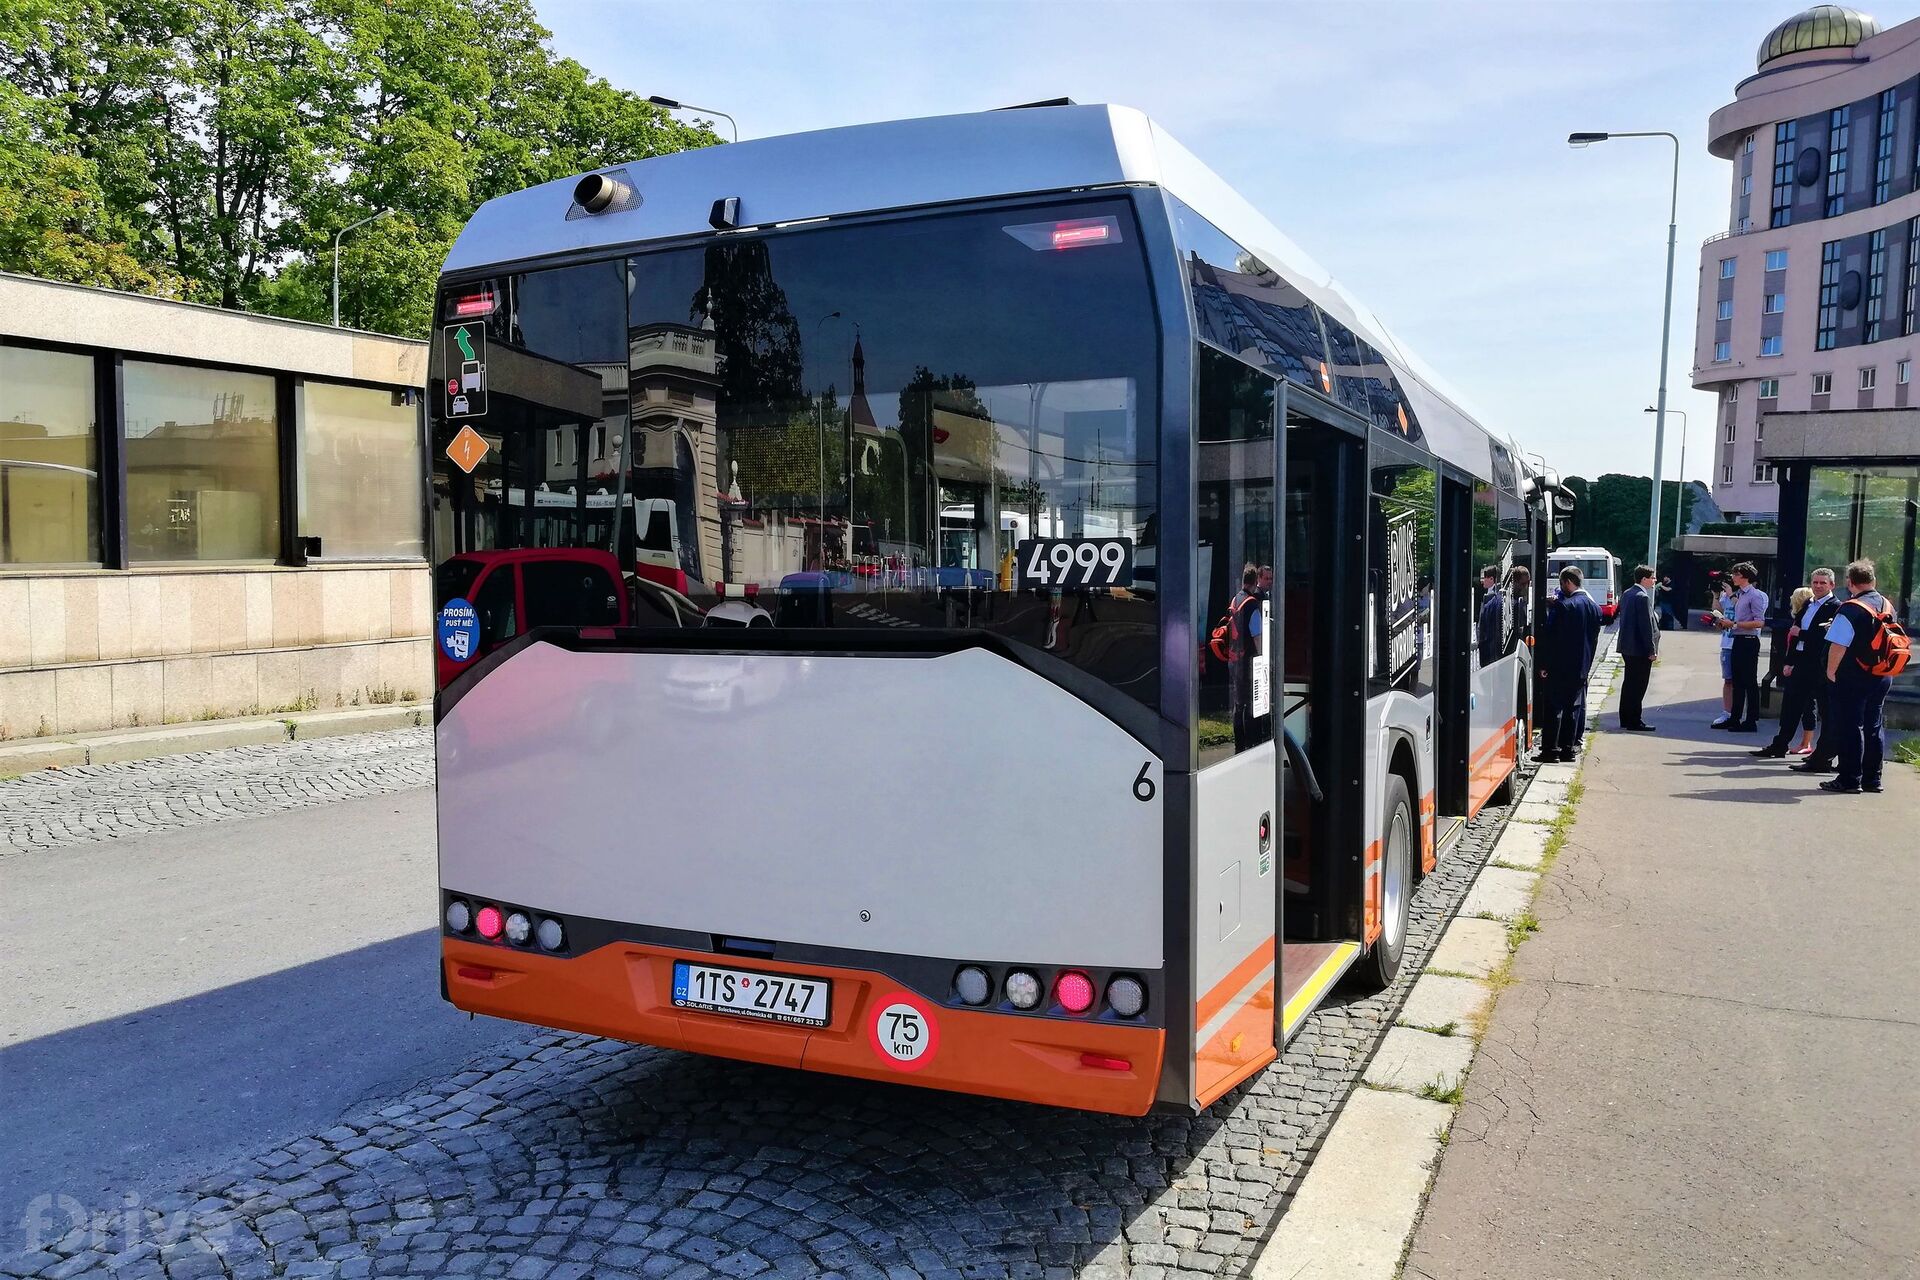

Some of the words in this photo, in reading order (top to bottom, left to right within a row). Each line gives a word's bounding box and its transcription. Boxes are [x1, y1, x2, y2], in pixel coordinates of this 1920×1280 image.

[1026, 541, 1125, 585] 4999
[1390, 520, 1414, 612] BUS
[443, 606, 475, 619] PROSÍM,
[1132, 761, 1156, 802] 6
[676, 986, 687, 996] CZ
[695, 970, 736, 1003] 1TS
[754, 978, 815, 1014] 2747
[686, 1001, 714, 1011] SOLARIS
[815, 1019, 824, 1027] 33
[886, 1012, 920, 1043] 75
[893, 1041, 913, 1056] km
